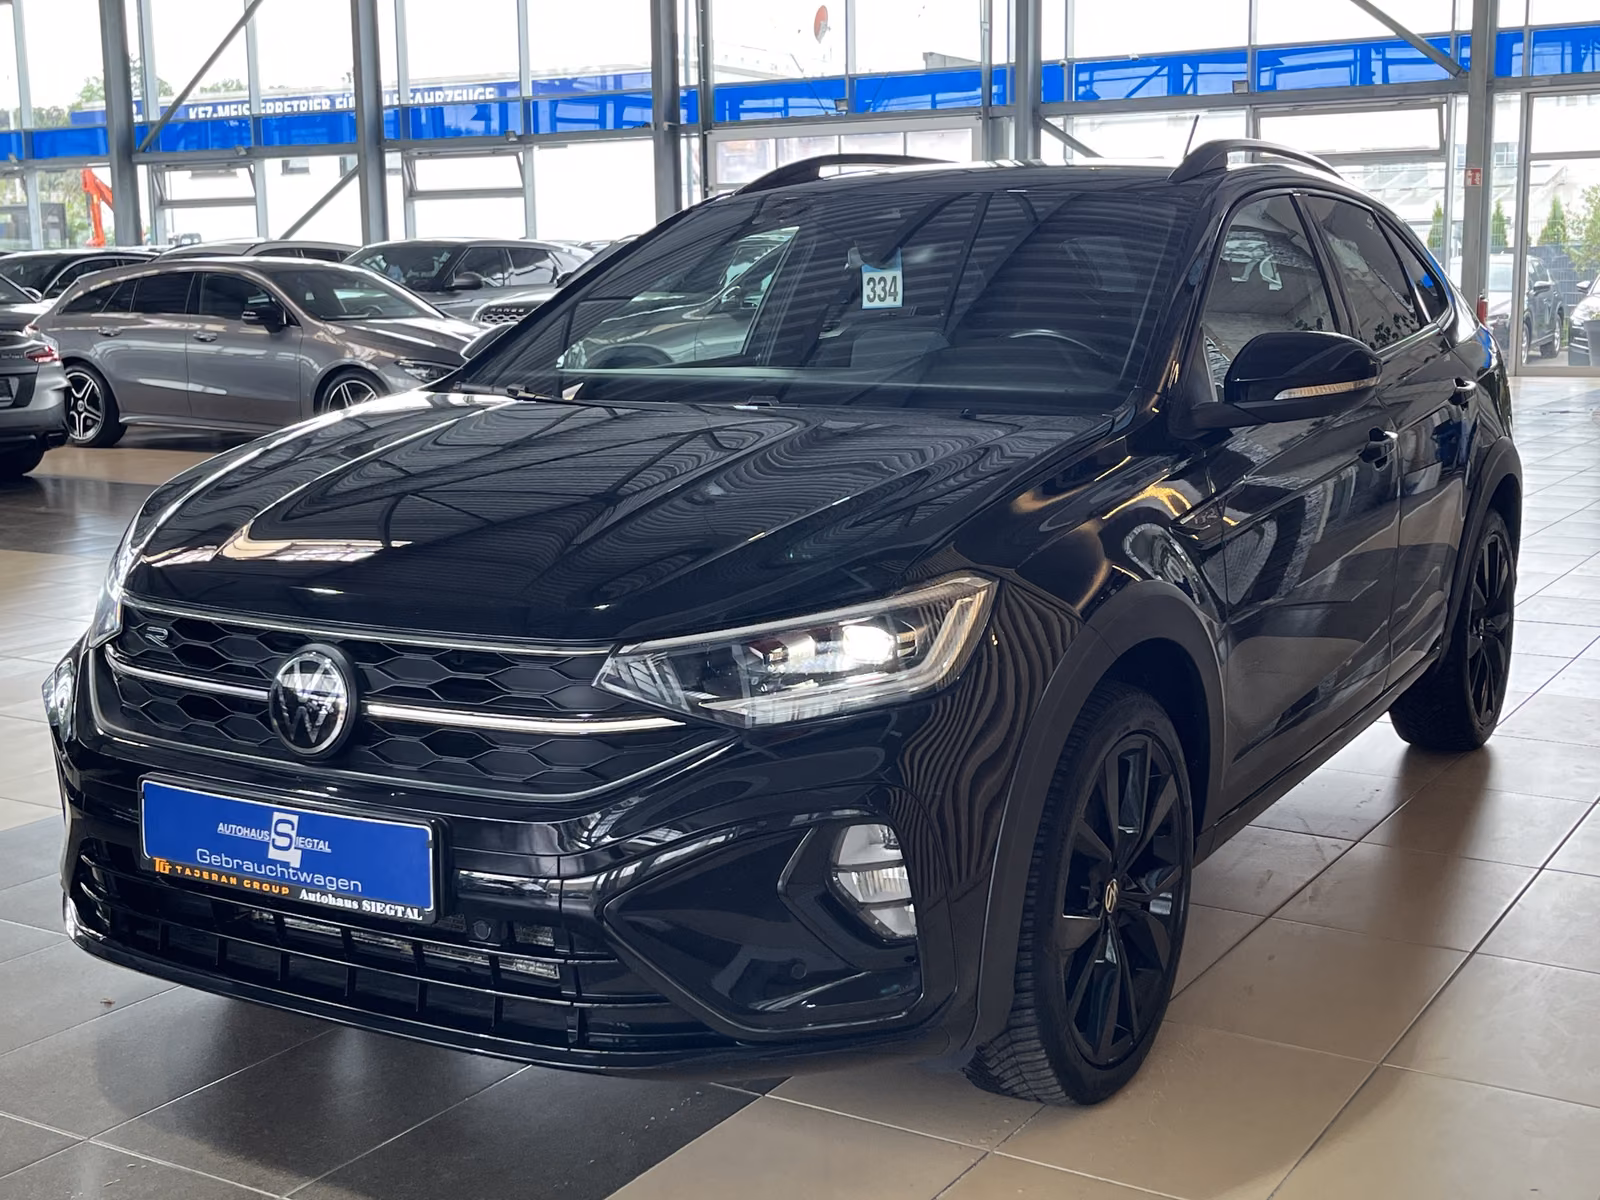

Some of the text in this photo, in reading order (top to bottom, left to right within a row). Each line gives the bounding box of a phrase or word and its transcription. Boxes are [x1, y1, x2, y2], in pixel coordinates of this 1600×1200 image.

[866, 275, 898, 303] 334
[216, 822, 270, 842] AUTOHAUS
[196, 848, 362, 893] Gebrauchtwagen
[175, 865, 238, 885] TAJERAN
[243, 879, 290, 895] GROUP
[299, 888, 359, 910] Autohaus
[361, 899, 423, 921] SIEGTAL
